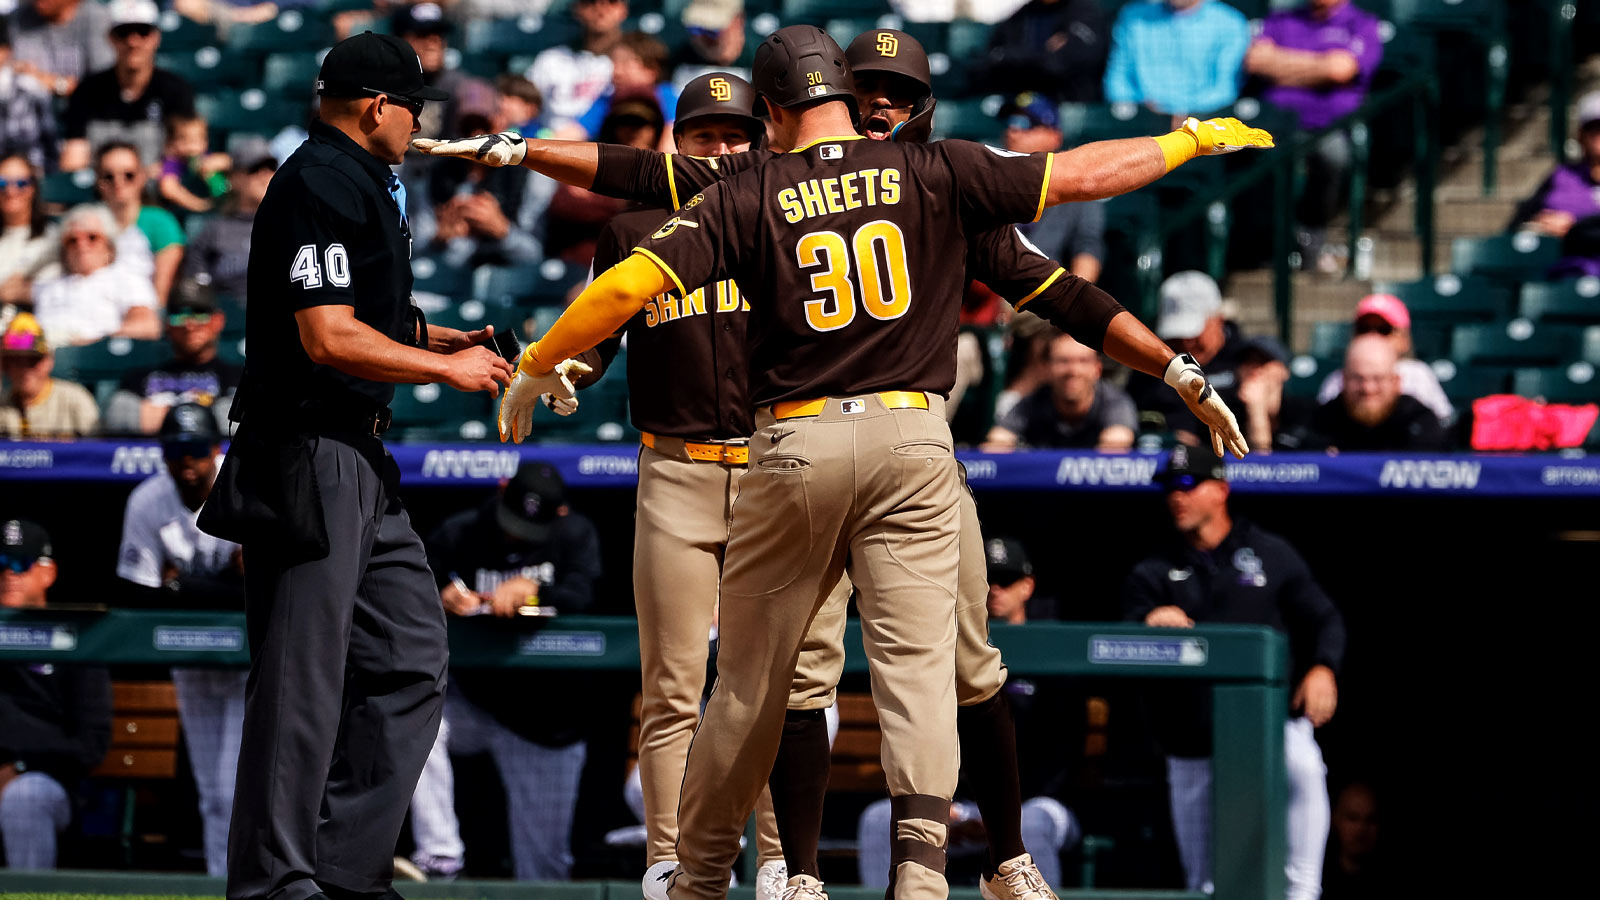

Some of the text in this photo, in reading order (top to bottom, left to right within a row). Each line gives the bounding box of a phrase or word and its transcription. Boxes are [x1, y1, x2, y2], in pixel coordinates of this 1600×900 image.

[876, 32, 898, 57] SD
[710, 78, 731, 101] SD
[806, 71, 823, 85] 30
[777, 168, 900, 223] SHEETS
[290, 243, 351, 289] 40
[796, 220, 912, 332] 30
[422, 450, 520, 478] ARROW
[1056, 457, 1158, 485] ARROW
[1379, 460, 1481, 489] ARROW
